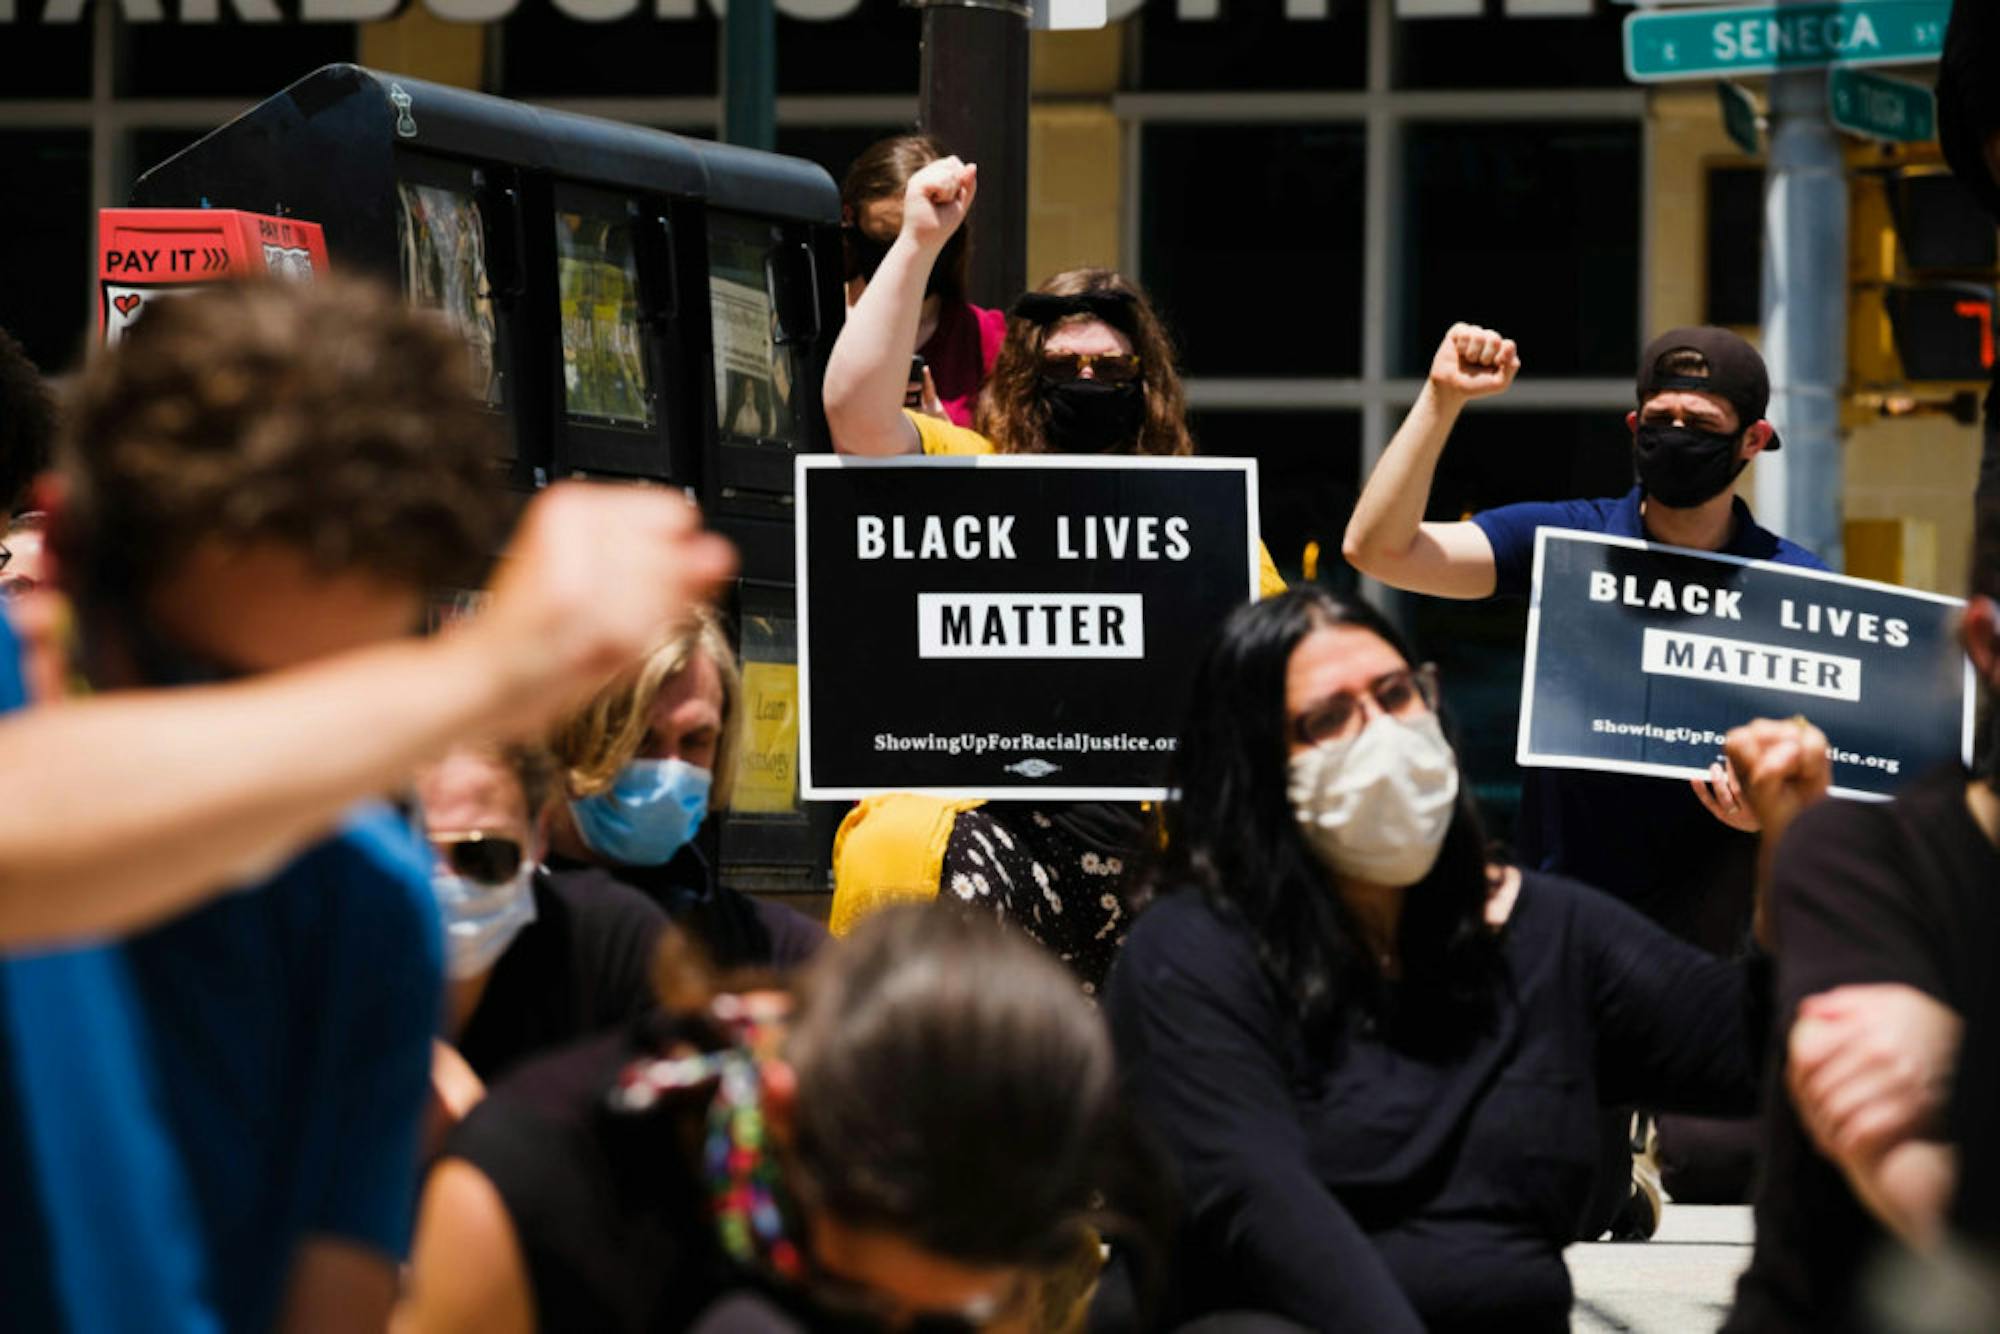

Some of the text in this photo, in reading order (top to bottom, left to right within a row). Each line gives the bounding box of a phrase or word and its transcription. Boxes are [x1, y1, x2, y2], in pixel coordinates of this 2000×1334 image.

[1712, 13, 1880, 60] SENECA
[106, 250, 196, 272] PAY IT
[856, 514, 1191, 561] BLACK LIVES
[940, 605, 1126, 647] MATTER
[1589, 570, 1910, 648] BLACK LIVES
[1664, 639, 1843, 691] MATTER
[873, 732, 1178, 755] ShowingUpForRacialJustice.or
